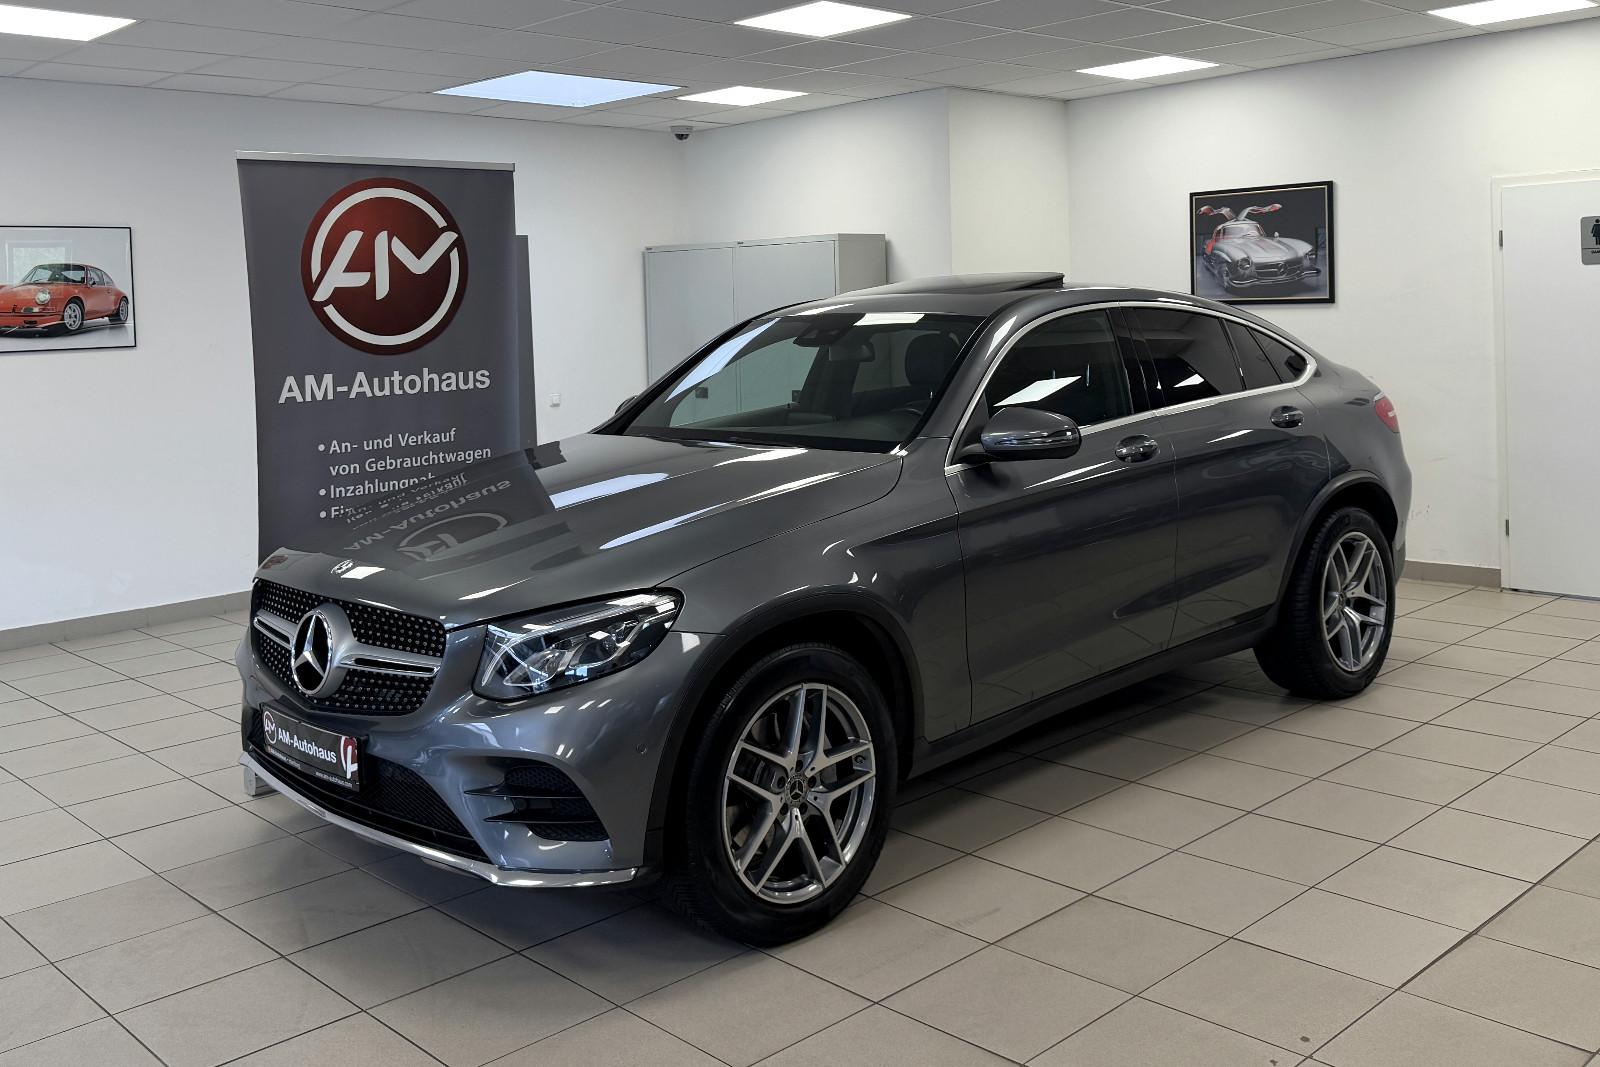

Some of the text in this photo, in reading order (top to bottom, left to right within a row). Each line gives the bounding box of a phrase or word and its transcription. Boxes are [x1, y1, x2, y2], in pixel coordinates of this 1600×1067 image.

[278, 367, 491, 404] AM-Autohaus
[329, 428, 457, 454] An- und Verkauf
[329, 448, 492, 476] von Gebrauchtwagen
[278, 727, 337, 763] AM-Autohaus
